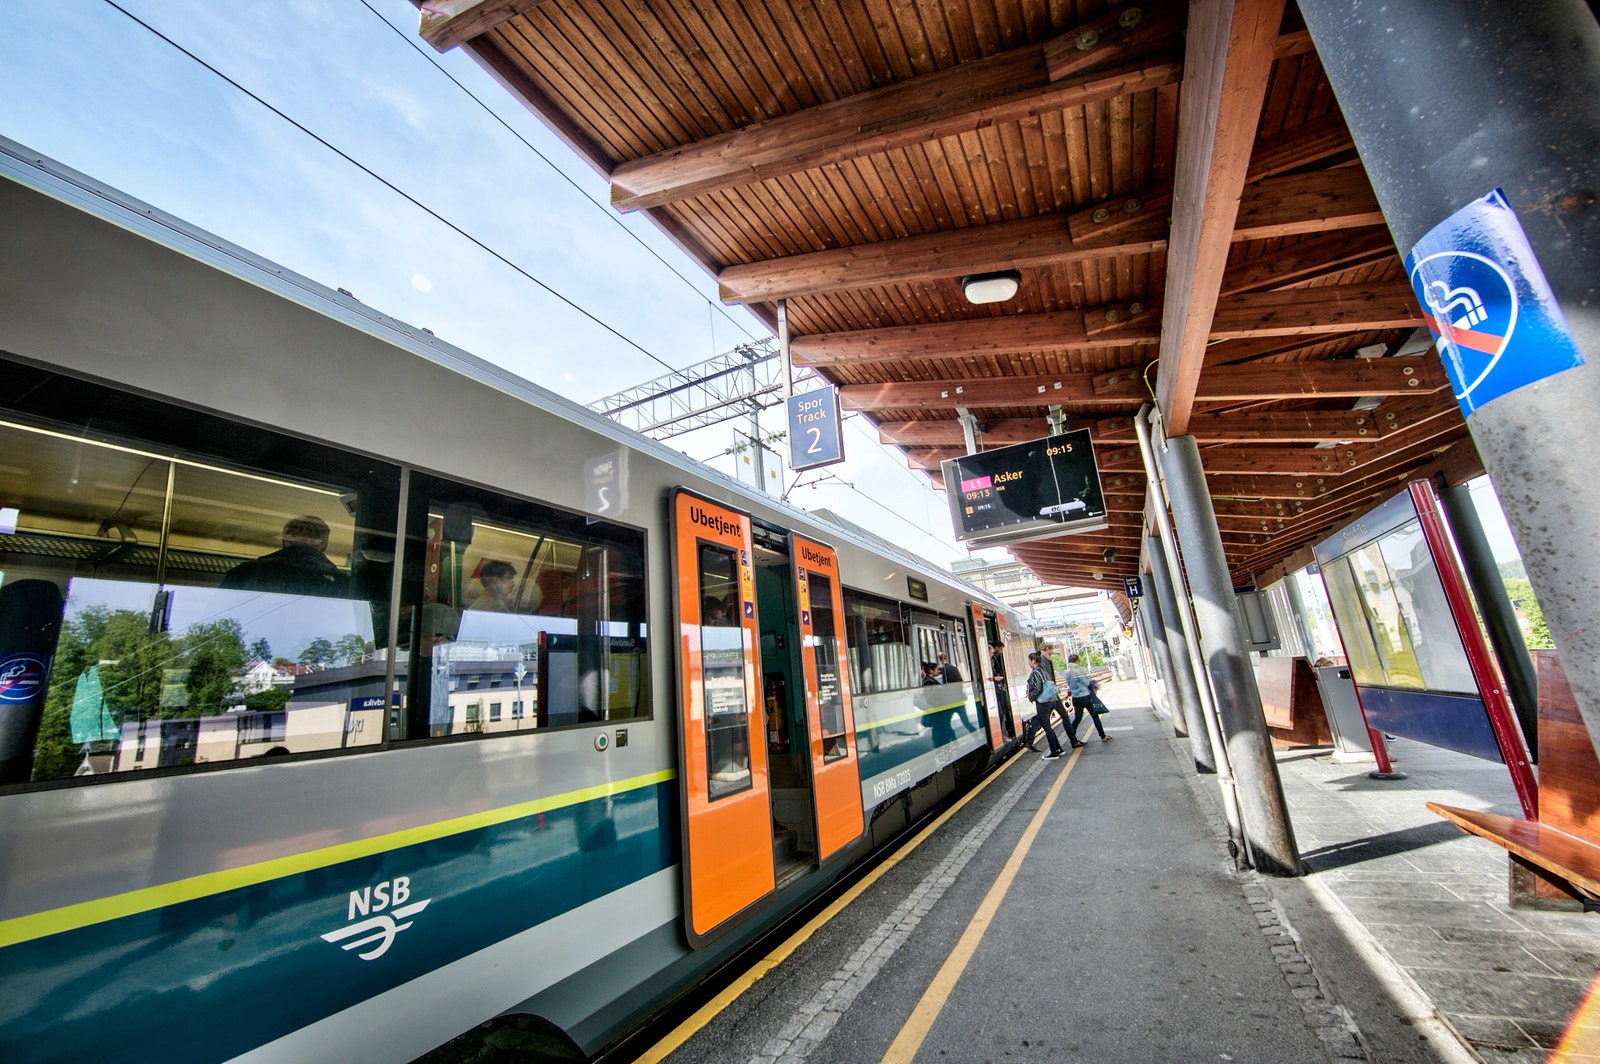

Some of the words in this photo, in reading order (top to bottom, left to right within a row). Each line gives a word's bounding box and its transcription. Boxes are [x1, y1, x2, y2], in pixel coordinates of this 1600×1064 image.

[798, 398, 823, 412] Spor
[796, 408, 826, 424] Track
[806, 427, 823, 454] 2
[1046, 444, 1072, 456] 09:15
[994, 470, 1024, 484] Asker
[966, 489, 990, 500] 09:13
[690, 506, 741, 538] Ubetjent
[802, 546, 832, 568] Ubetjent
[1129, 585, 1138, 596] H
[874, 780, 886, 799] NSB
[348, 876, 410, 920] NSB
